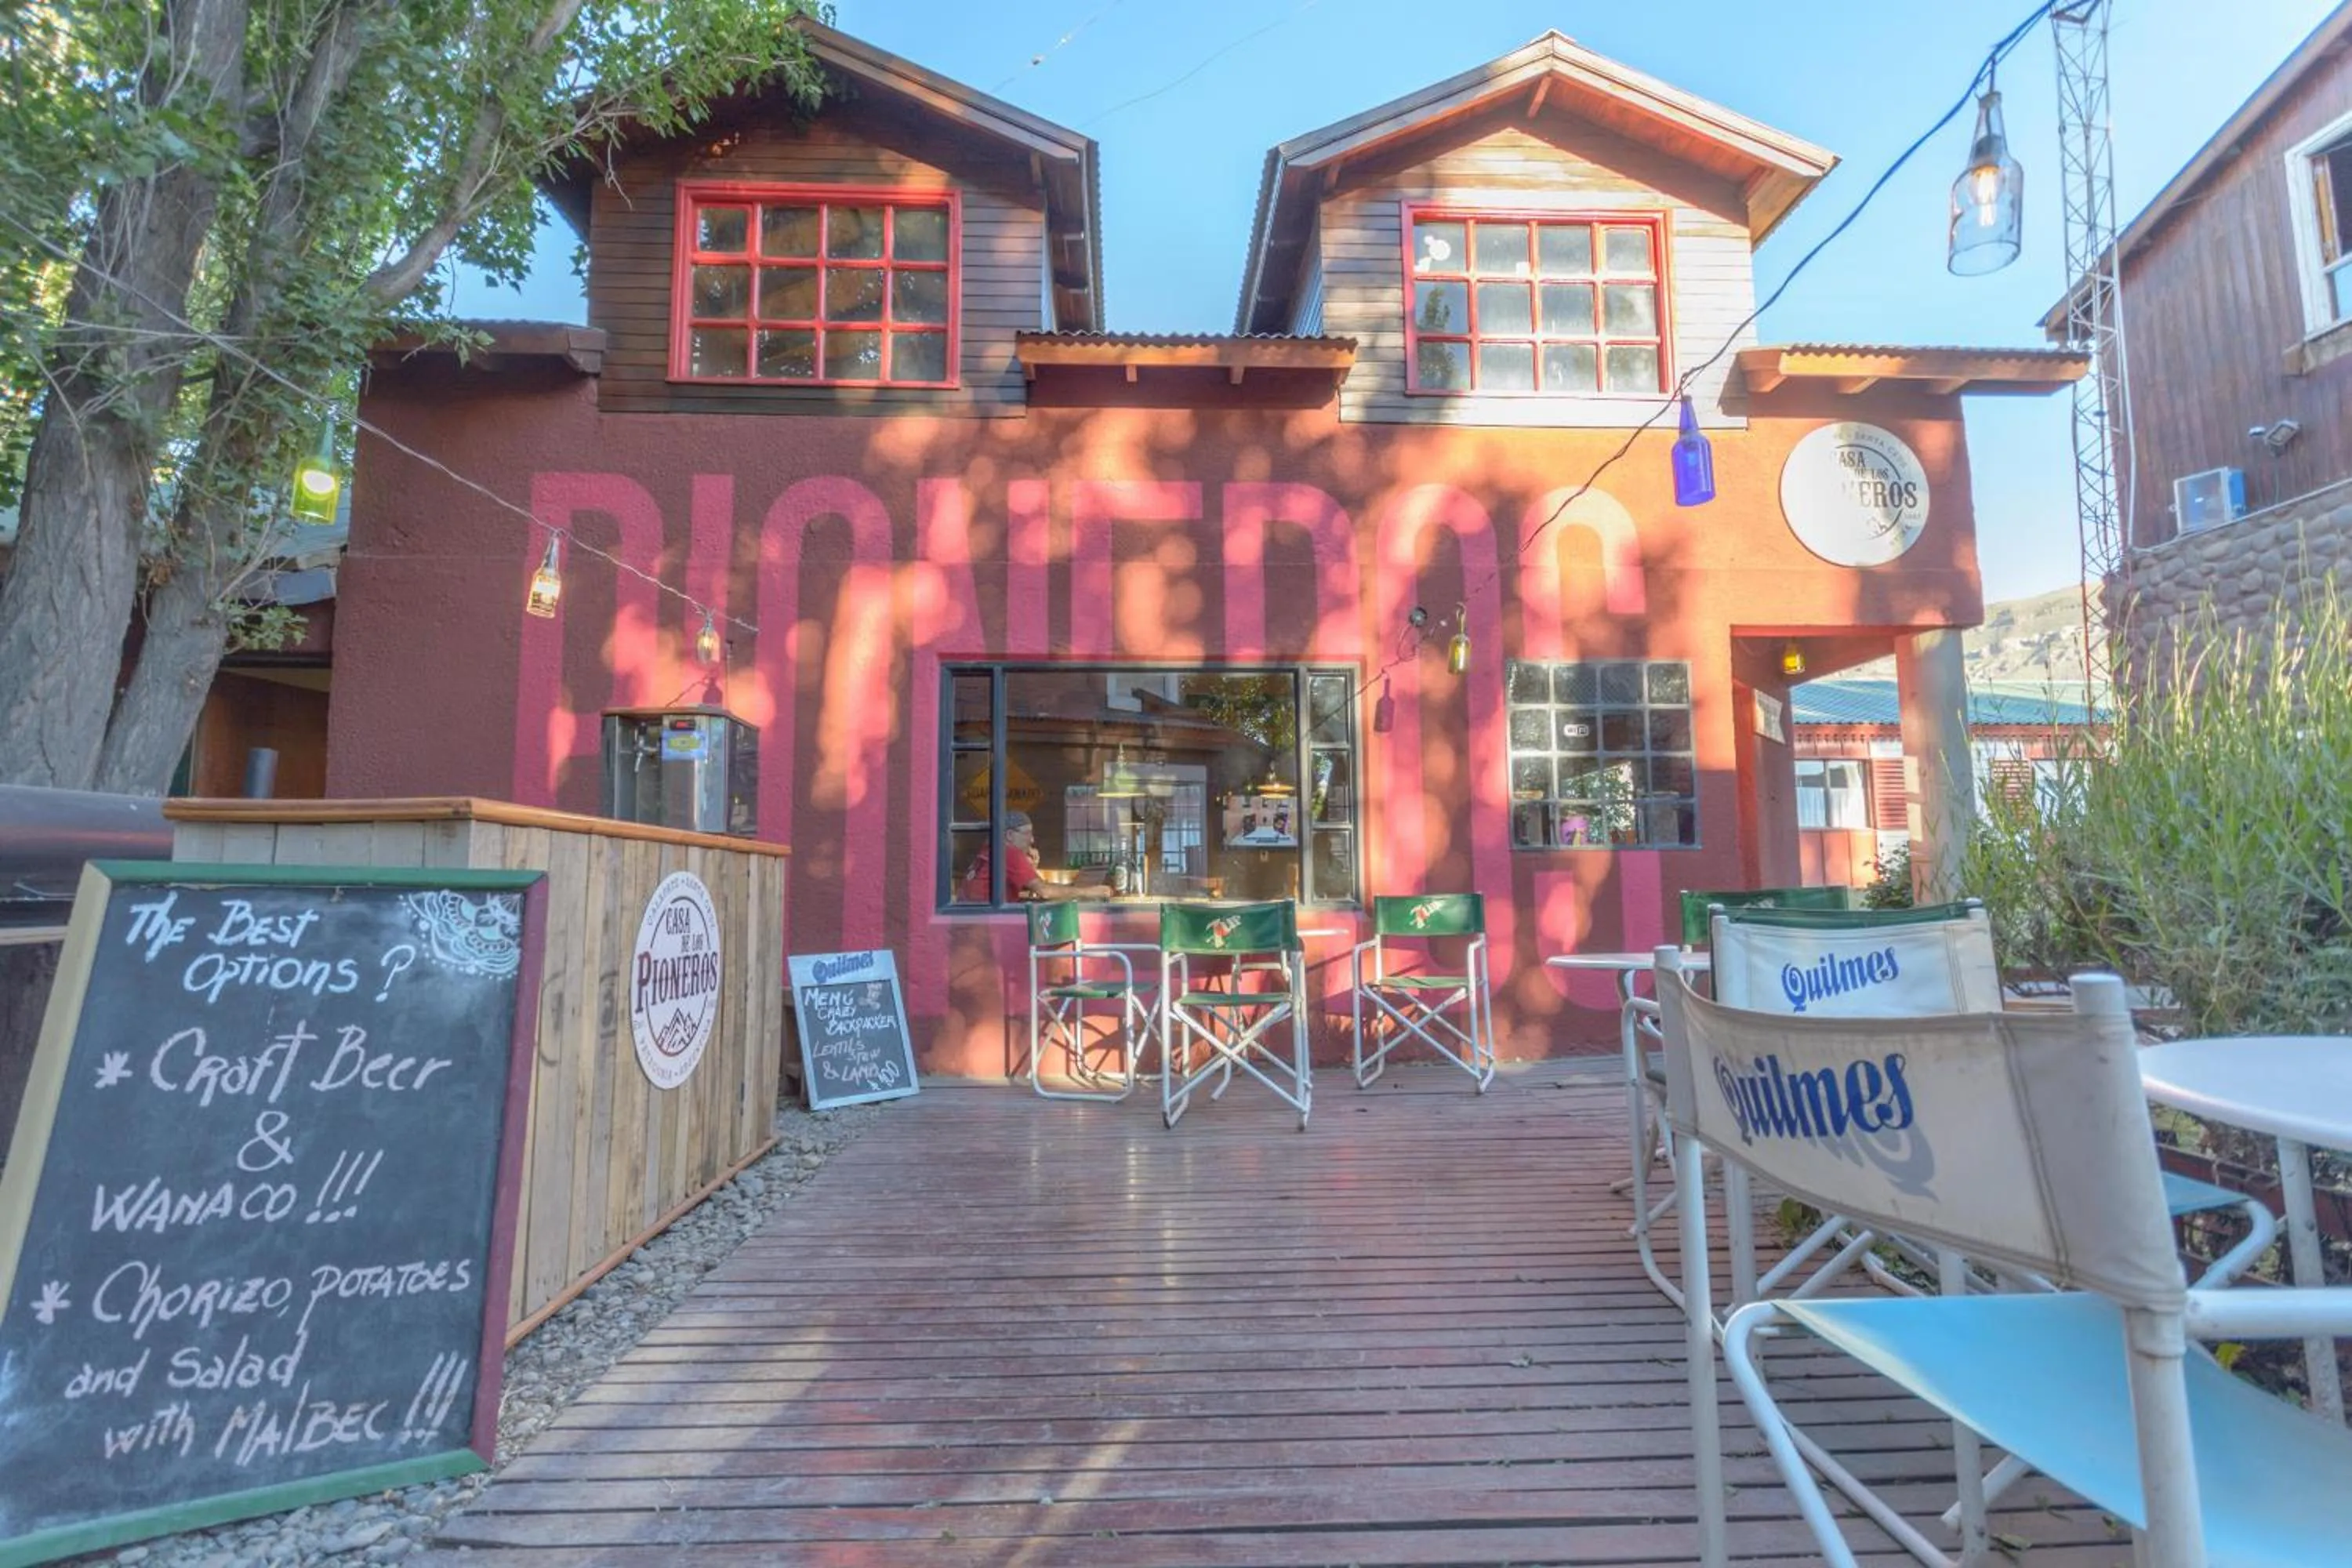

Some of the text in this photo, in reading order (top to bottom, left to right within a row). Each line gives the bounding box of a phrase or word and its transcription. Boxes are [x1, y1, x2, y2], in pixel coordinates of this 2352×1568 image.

[666, 907, 690, 935] CASA
[634, 950, 717, 1014] PIONEROS
[1781, 946, 1899, 1012] Quilmes
[310, 1024, 453, 1092] Beer
[1713, 1053, 1914, 1146] Quilmes
[237, 1110, 294, 1172] &
[64, 1347, 151, 1399] and
